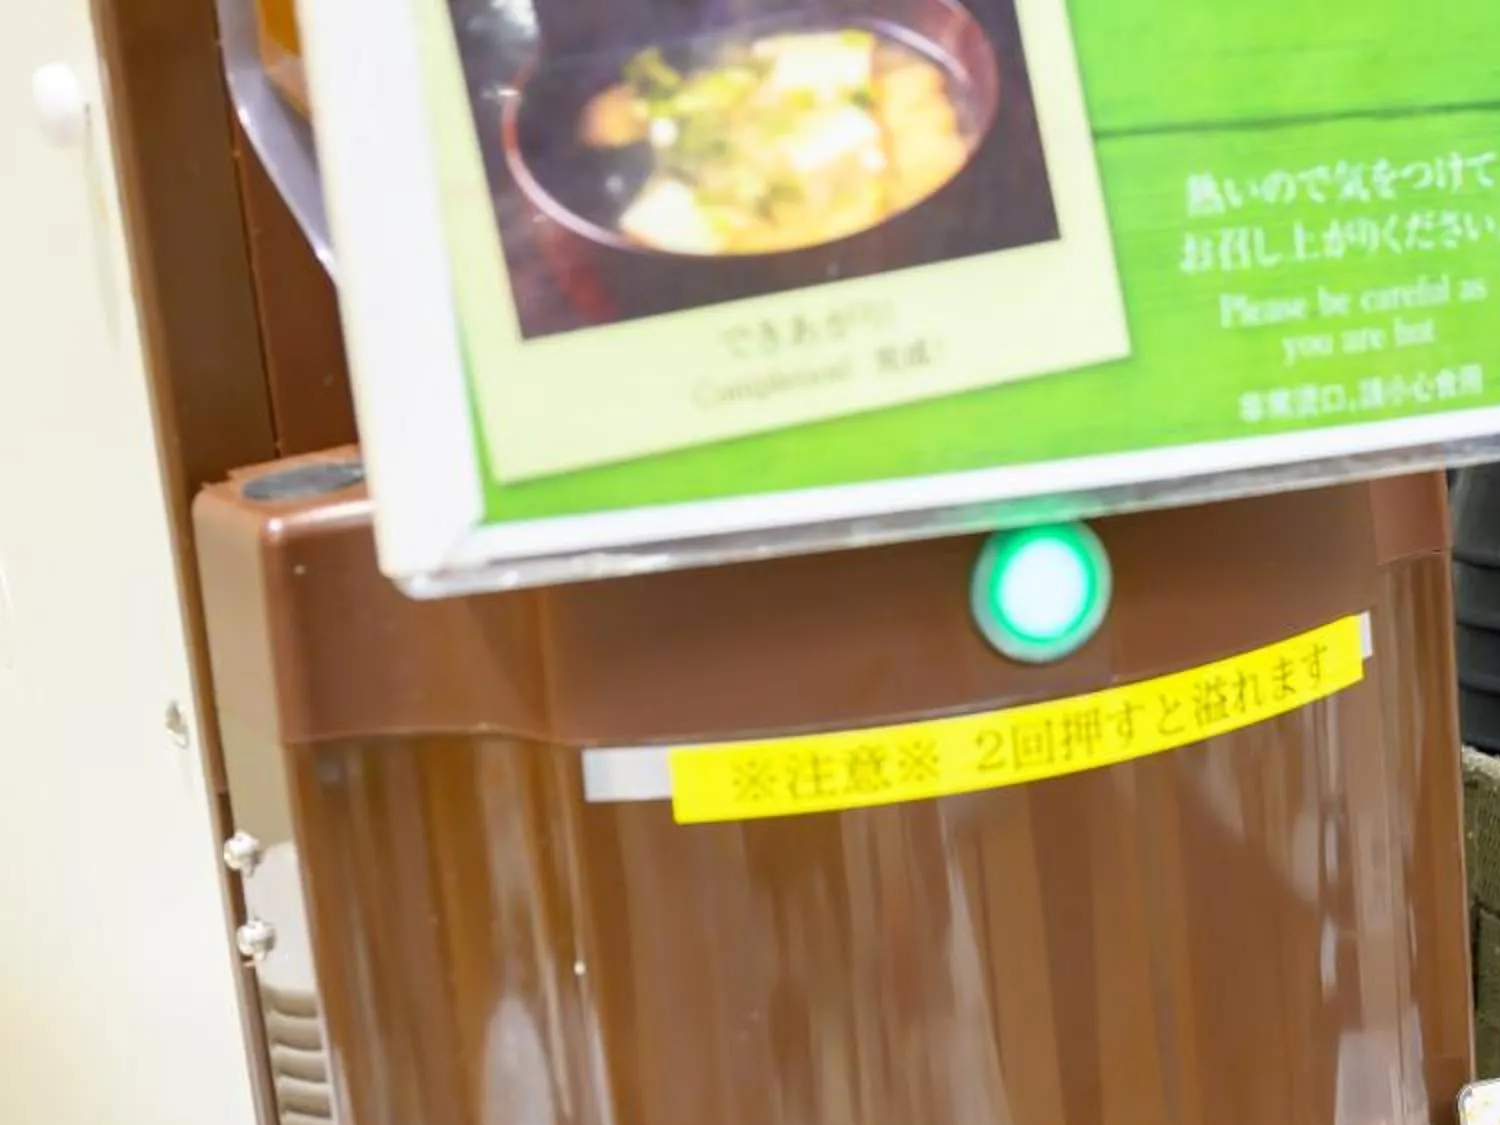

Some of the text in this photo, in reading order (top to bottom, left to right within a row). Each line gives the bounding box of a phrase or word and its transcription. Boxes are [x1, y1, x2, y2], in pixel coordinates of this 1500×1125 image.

[1219, 292, 1308, 328] Please
[1317, 285, 1350, 317] be
[1459, 278, 1488, 302] as
[1283, 318, 1436, 367] you are hot
